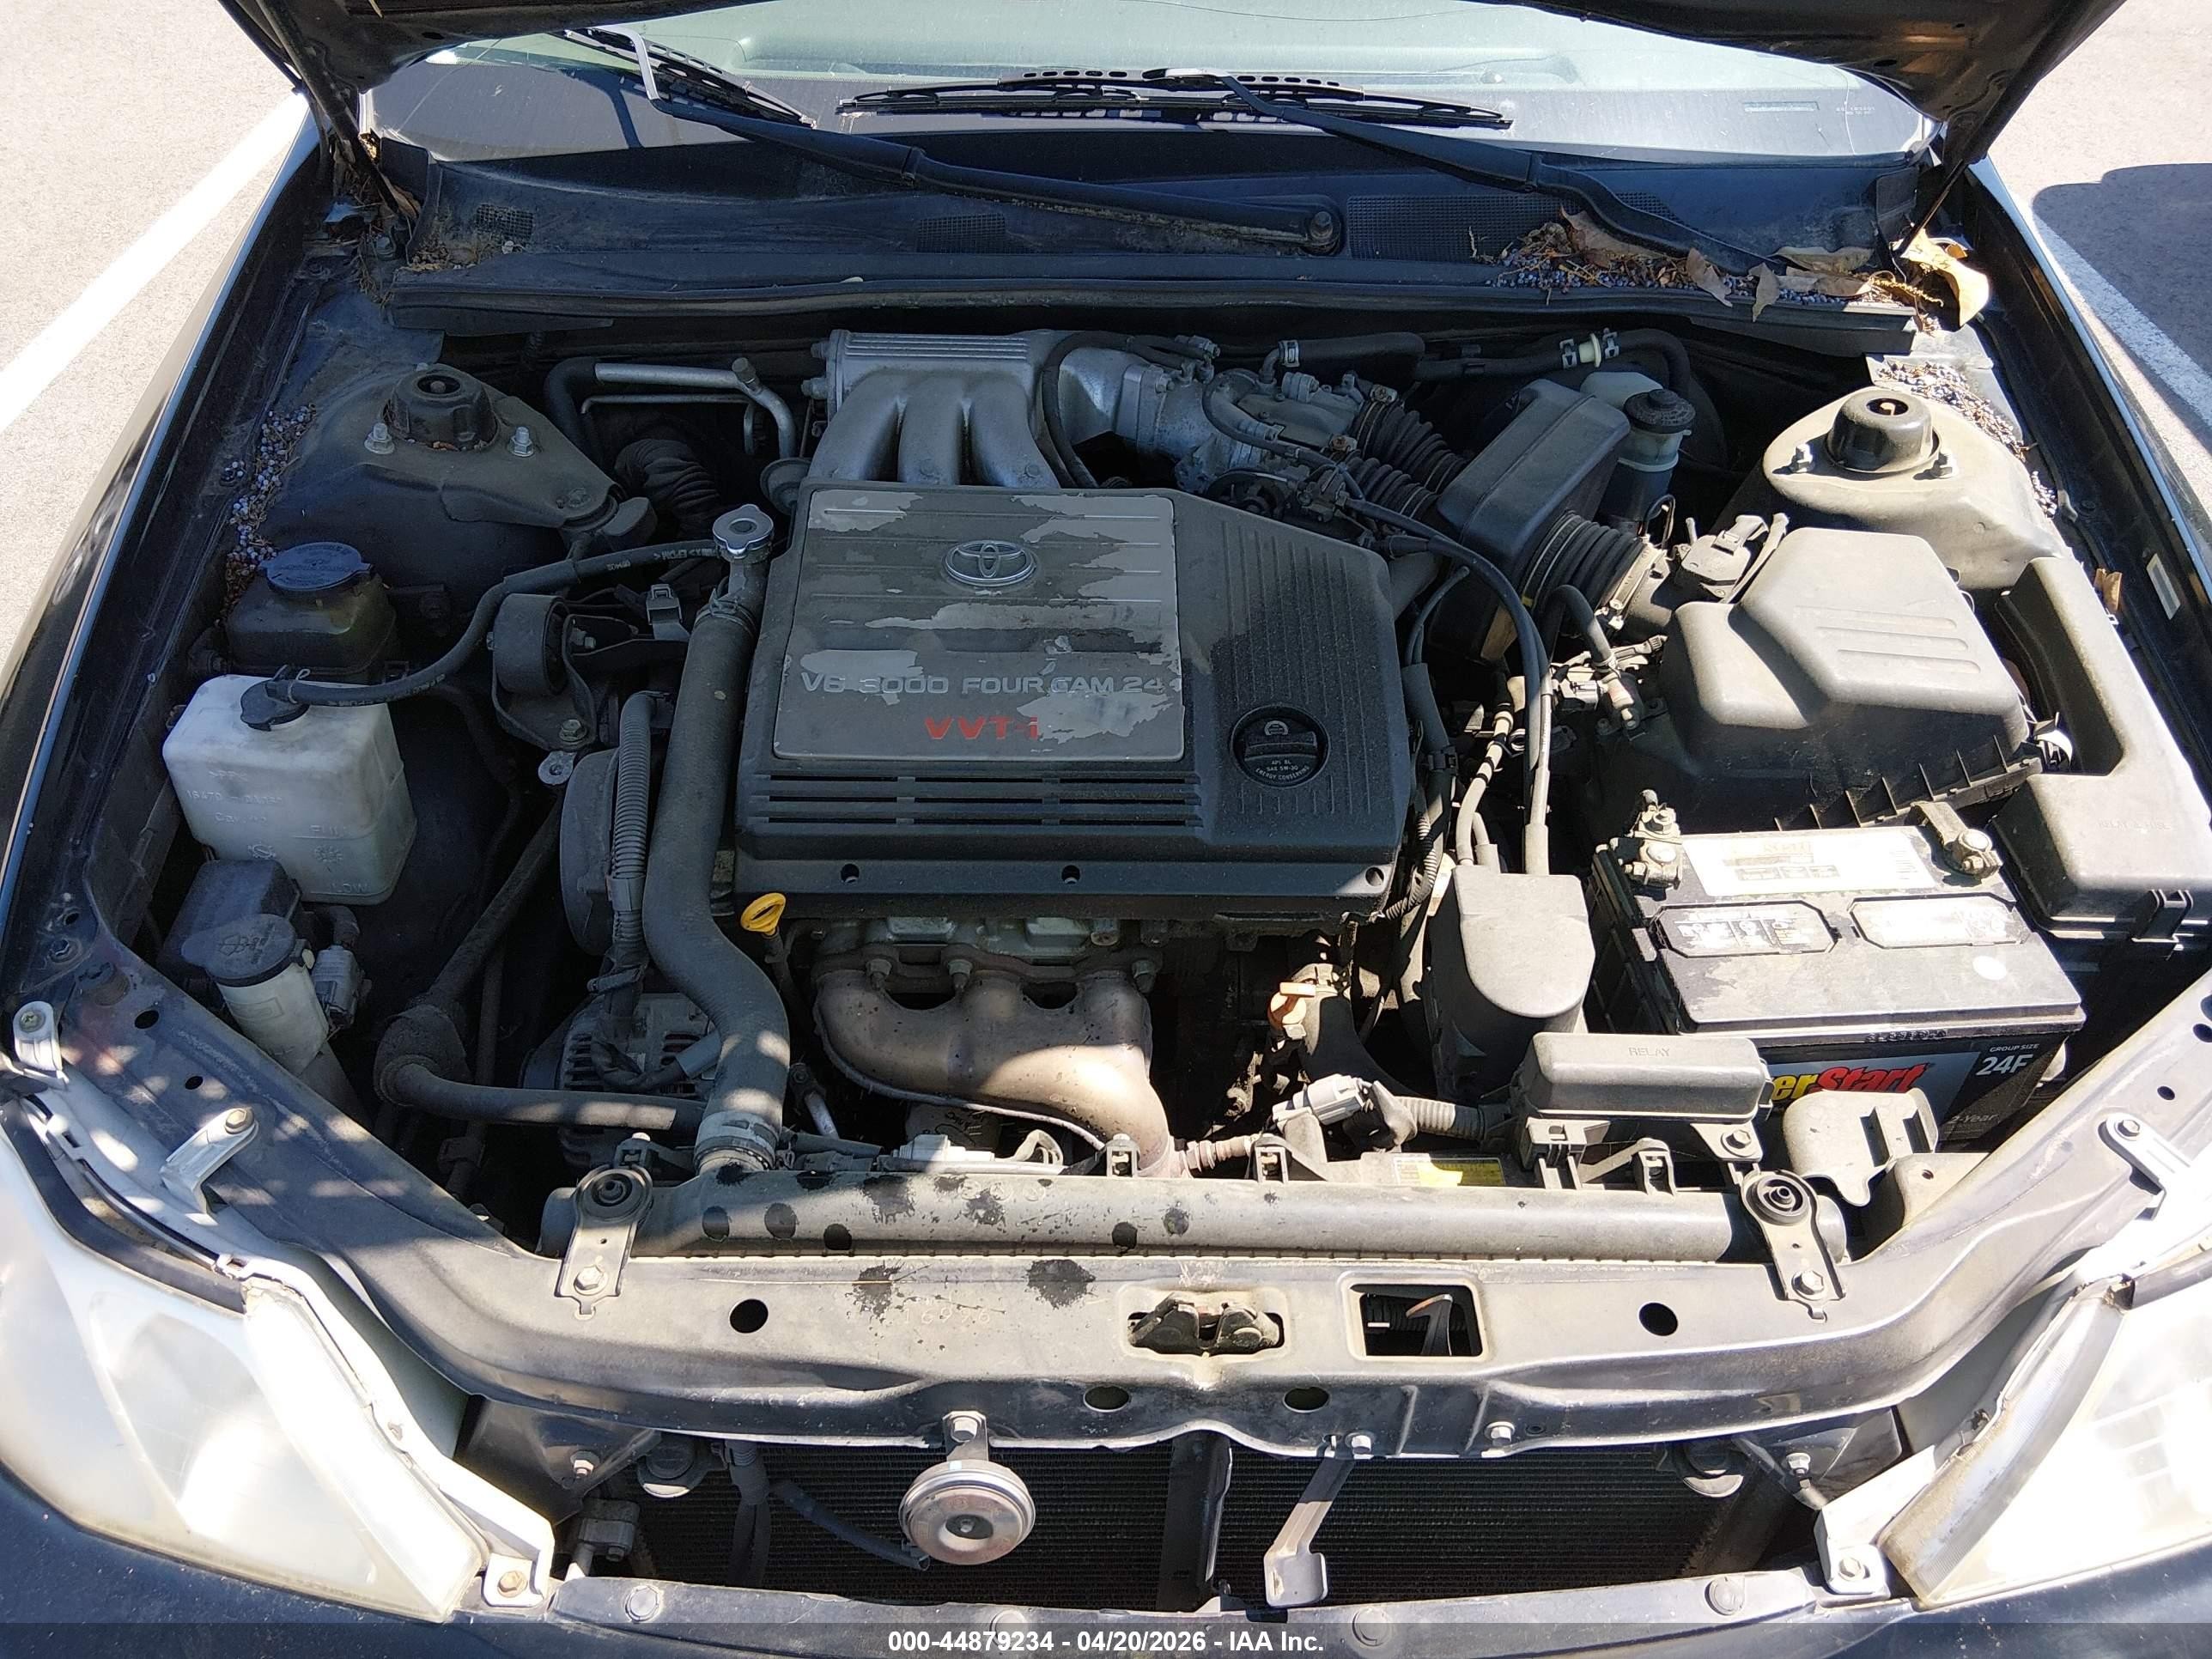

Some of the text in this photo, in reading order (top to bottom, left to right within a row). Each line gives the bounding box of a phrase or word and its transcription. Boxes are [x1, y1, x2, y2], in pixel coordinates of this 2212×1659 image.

[800, 672, 846, 693] V6
[859, 676, 949, 694] 3000
[962, 675, 1045, 695] FOUR
[1050, 676, 1114, 694] CAM
[924, 715, 1038, 740] VVT-i
[1628, 1047, 1670, 1057] RELAY
[1989, 1044, 2020, 1053] GROUP
[1976, 1054, 2034, 1076] 24F
[1771, 1062, 1930, 1101] erStart
